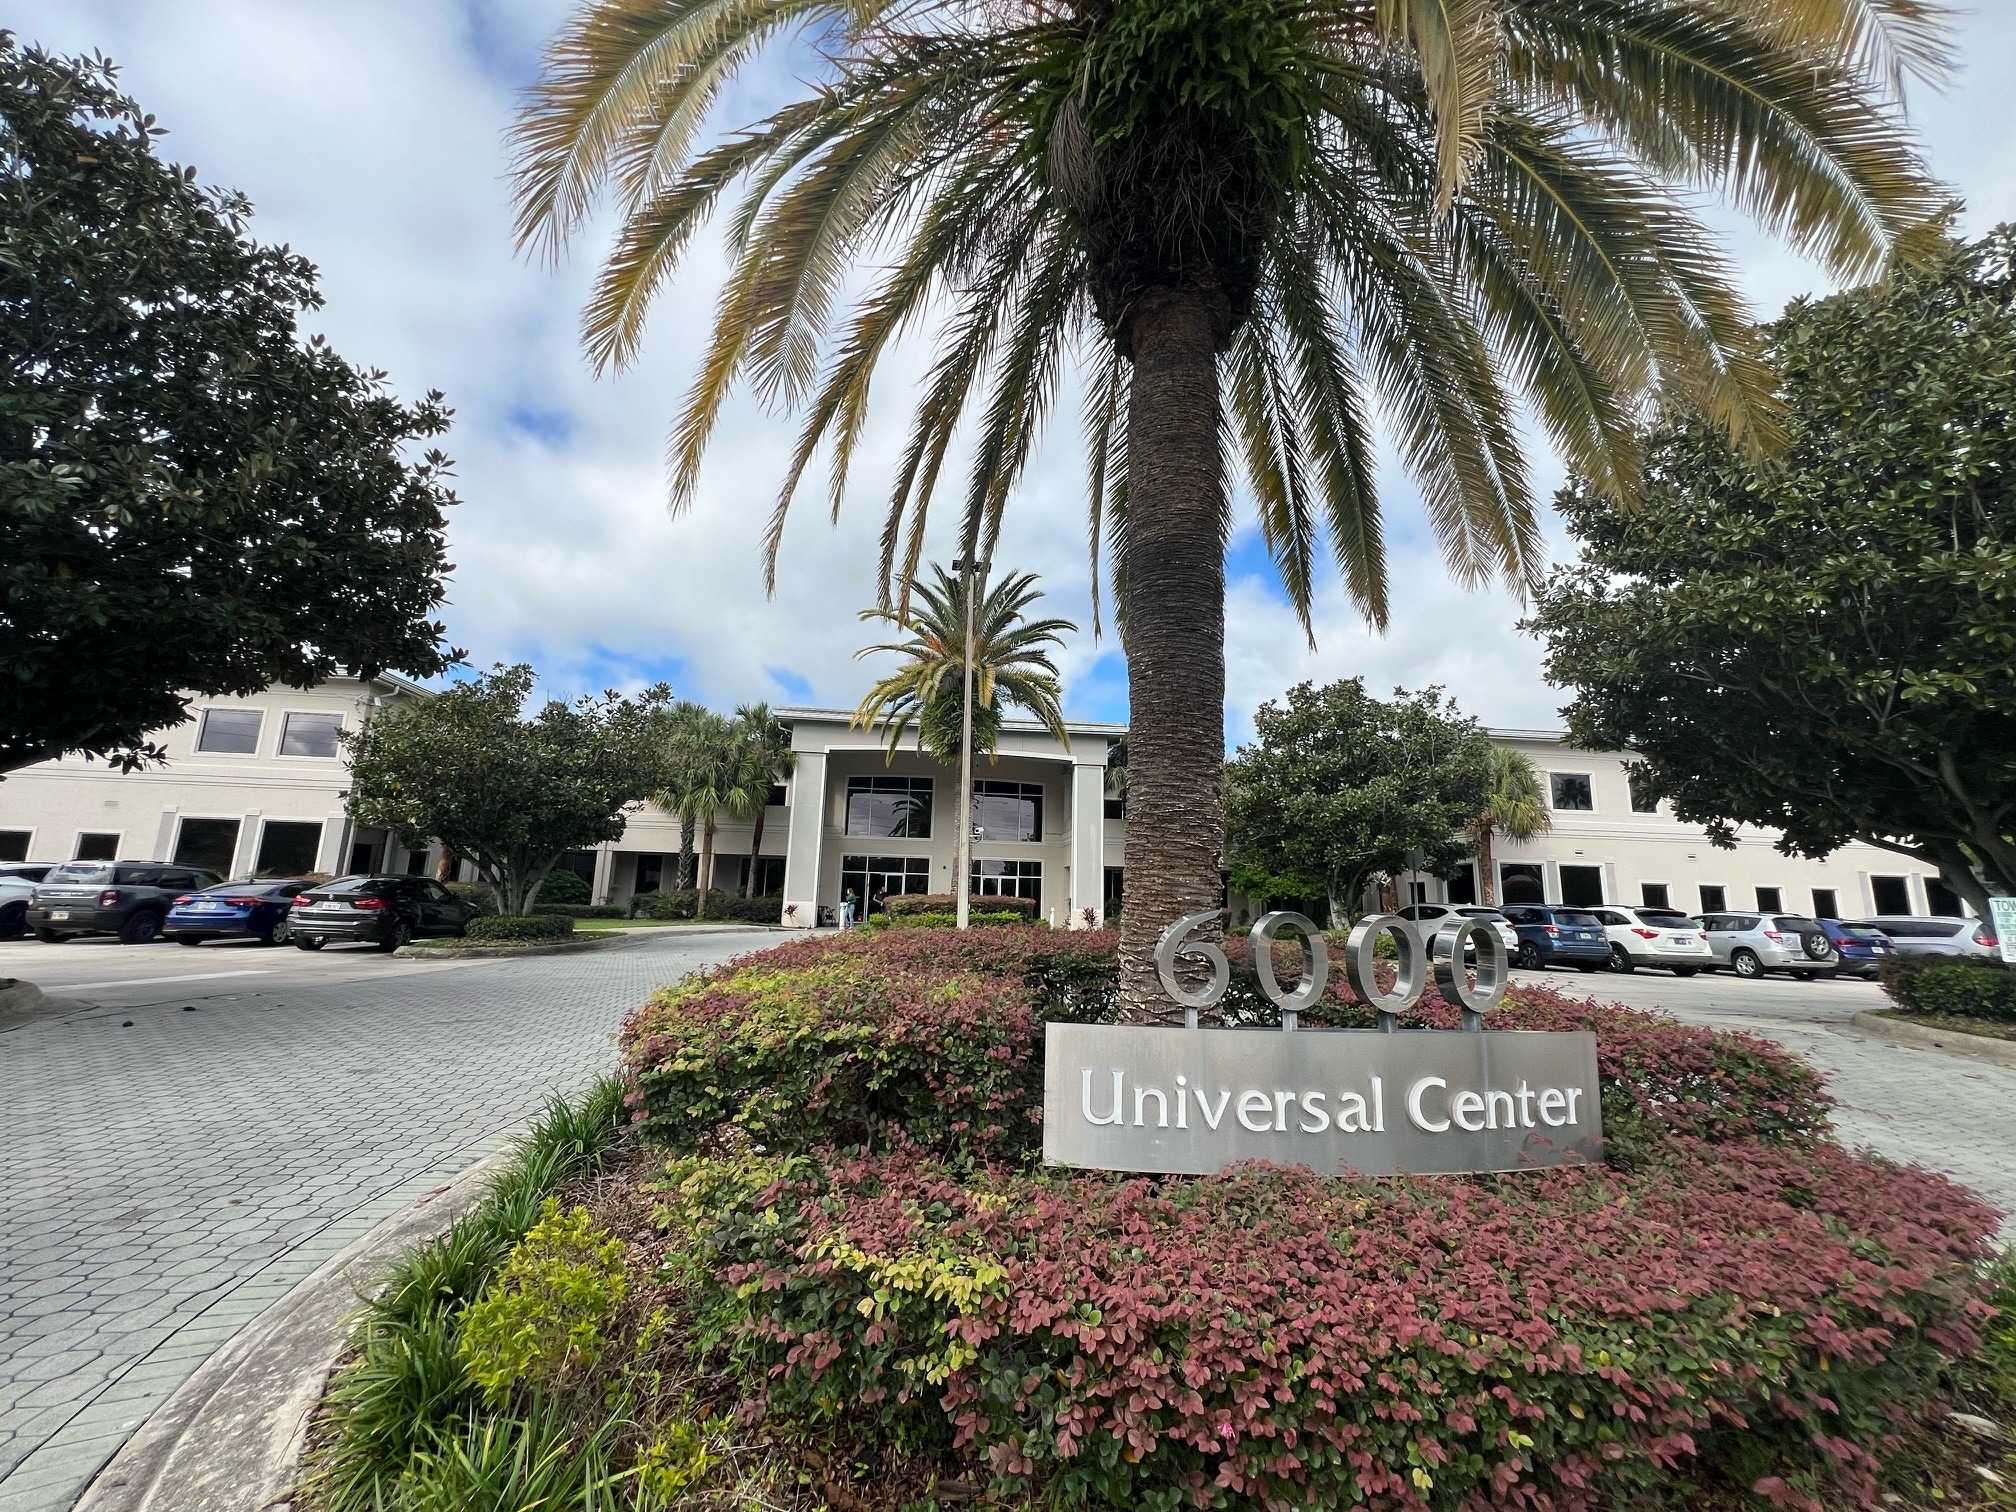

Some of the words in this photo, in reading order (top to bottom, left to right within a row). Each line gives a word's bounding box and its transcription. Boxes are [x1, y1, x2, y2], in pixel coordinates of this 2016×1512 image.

[1153, 909, 1508, 1014] 6000
[1080, 1068, 1386, 1134] Universal
[1406, 1075, 1583, 1133] Center
